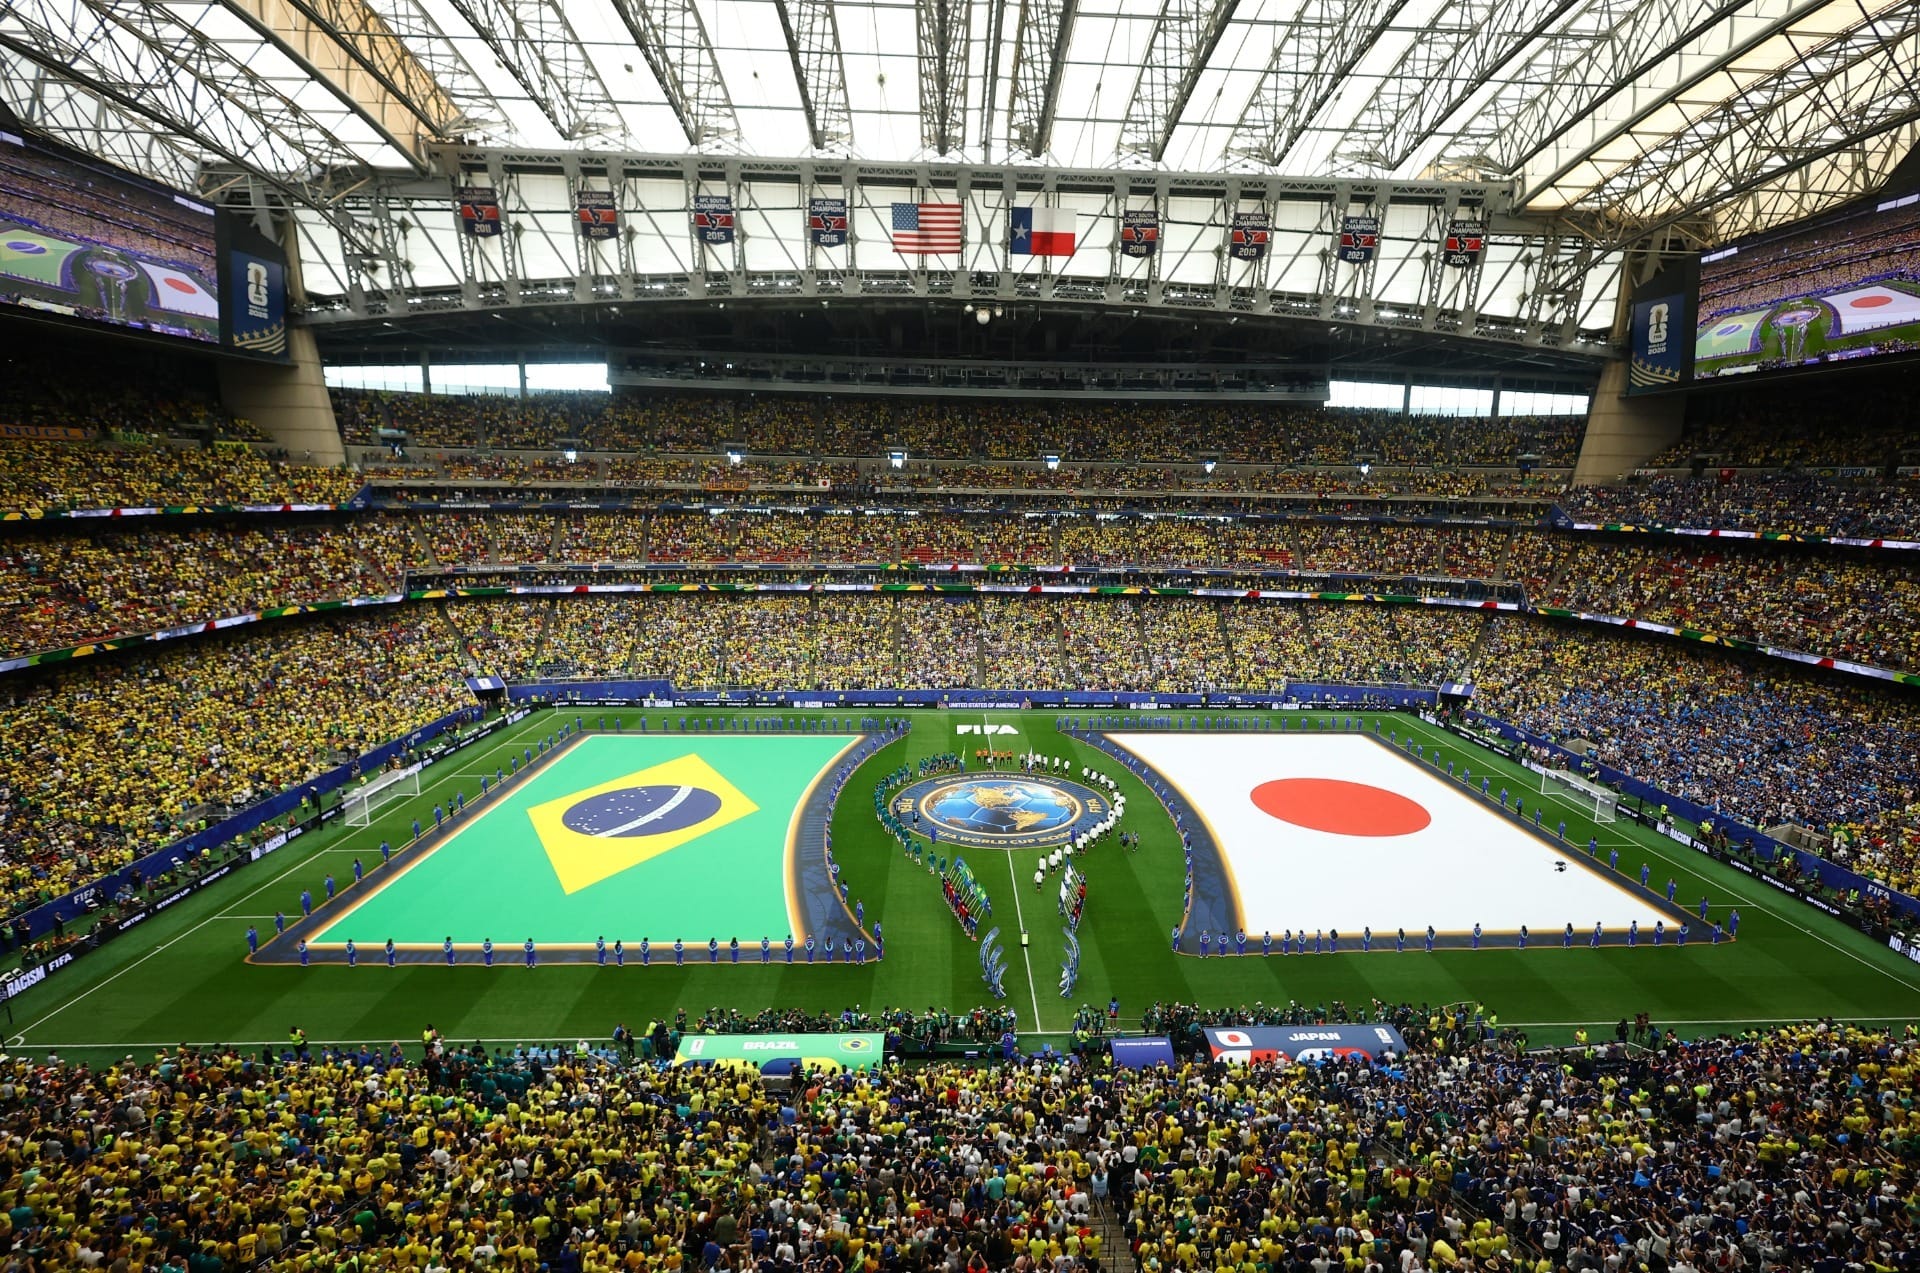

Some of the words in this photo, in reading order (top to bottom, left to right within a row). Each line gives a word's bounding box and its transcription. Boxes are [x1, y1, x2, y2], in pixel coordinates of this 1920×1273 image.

[475, 224, 491, 233] 2011
[706, 231, 726, 241] 2015
[820, 234, 838, 243] 2016
[1128, 245, 1147, 253] 2018
[1238, 248, 1257, 256] 2019
[1347, 251, 1365, 260] 2023
[1450, 255, 1470, 264] 2024
[956, 724, 1019, 735] FIFA
[288, 826, 303, 839] FIFA
[960, 836, 1007, 845] WORLD
[1656, 822, 1665, 834] NO
[1670, 829, 1692, 847] RACISM
[1692, 840, 1709, 854] FIFA
[1730, 859, 1753, 873] LISTEN
[1762, 874, 1783, 888] STAND
[1783, 884, 1796, 893] UP
[1806, 895, 1828, 910] SHOW
[1827, 906, 1841, 915] UP
[1867, 884, 1890, 900] FIFA
[73, 887, 96, 905] FIFA
[118, 912, 146, 930] LISTEN
[156, 894, 181, 910] STAND
[180, 888, 191, 897] UP
[200, 872, 220, 886] SHOW
[219, 866, 230, 875] UP
[1889, 935, 1902, 952] NO
[6, 965, 46, 998] RACISM
[48, 952, 73, 972] FIFA
[1288, 1031, 1341, 1042] JAPAN
[743, 1041, 800, 1051] BRAZIL
[241, 1247, 253, 1257] 77
